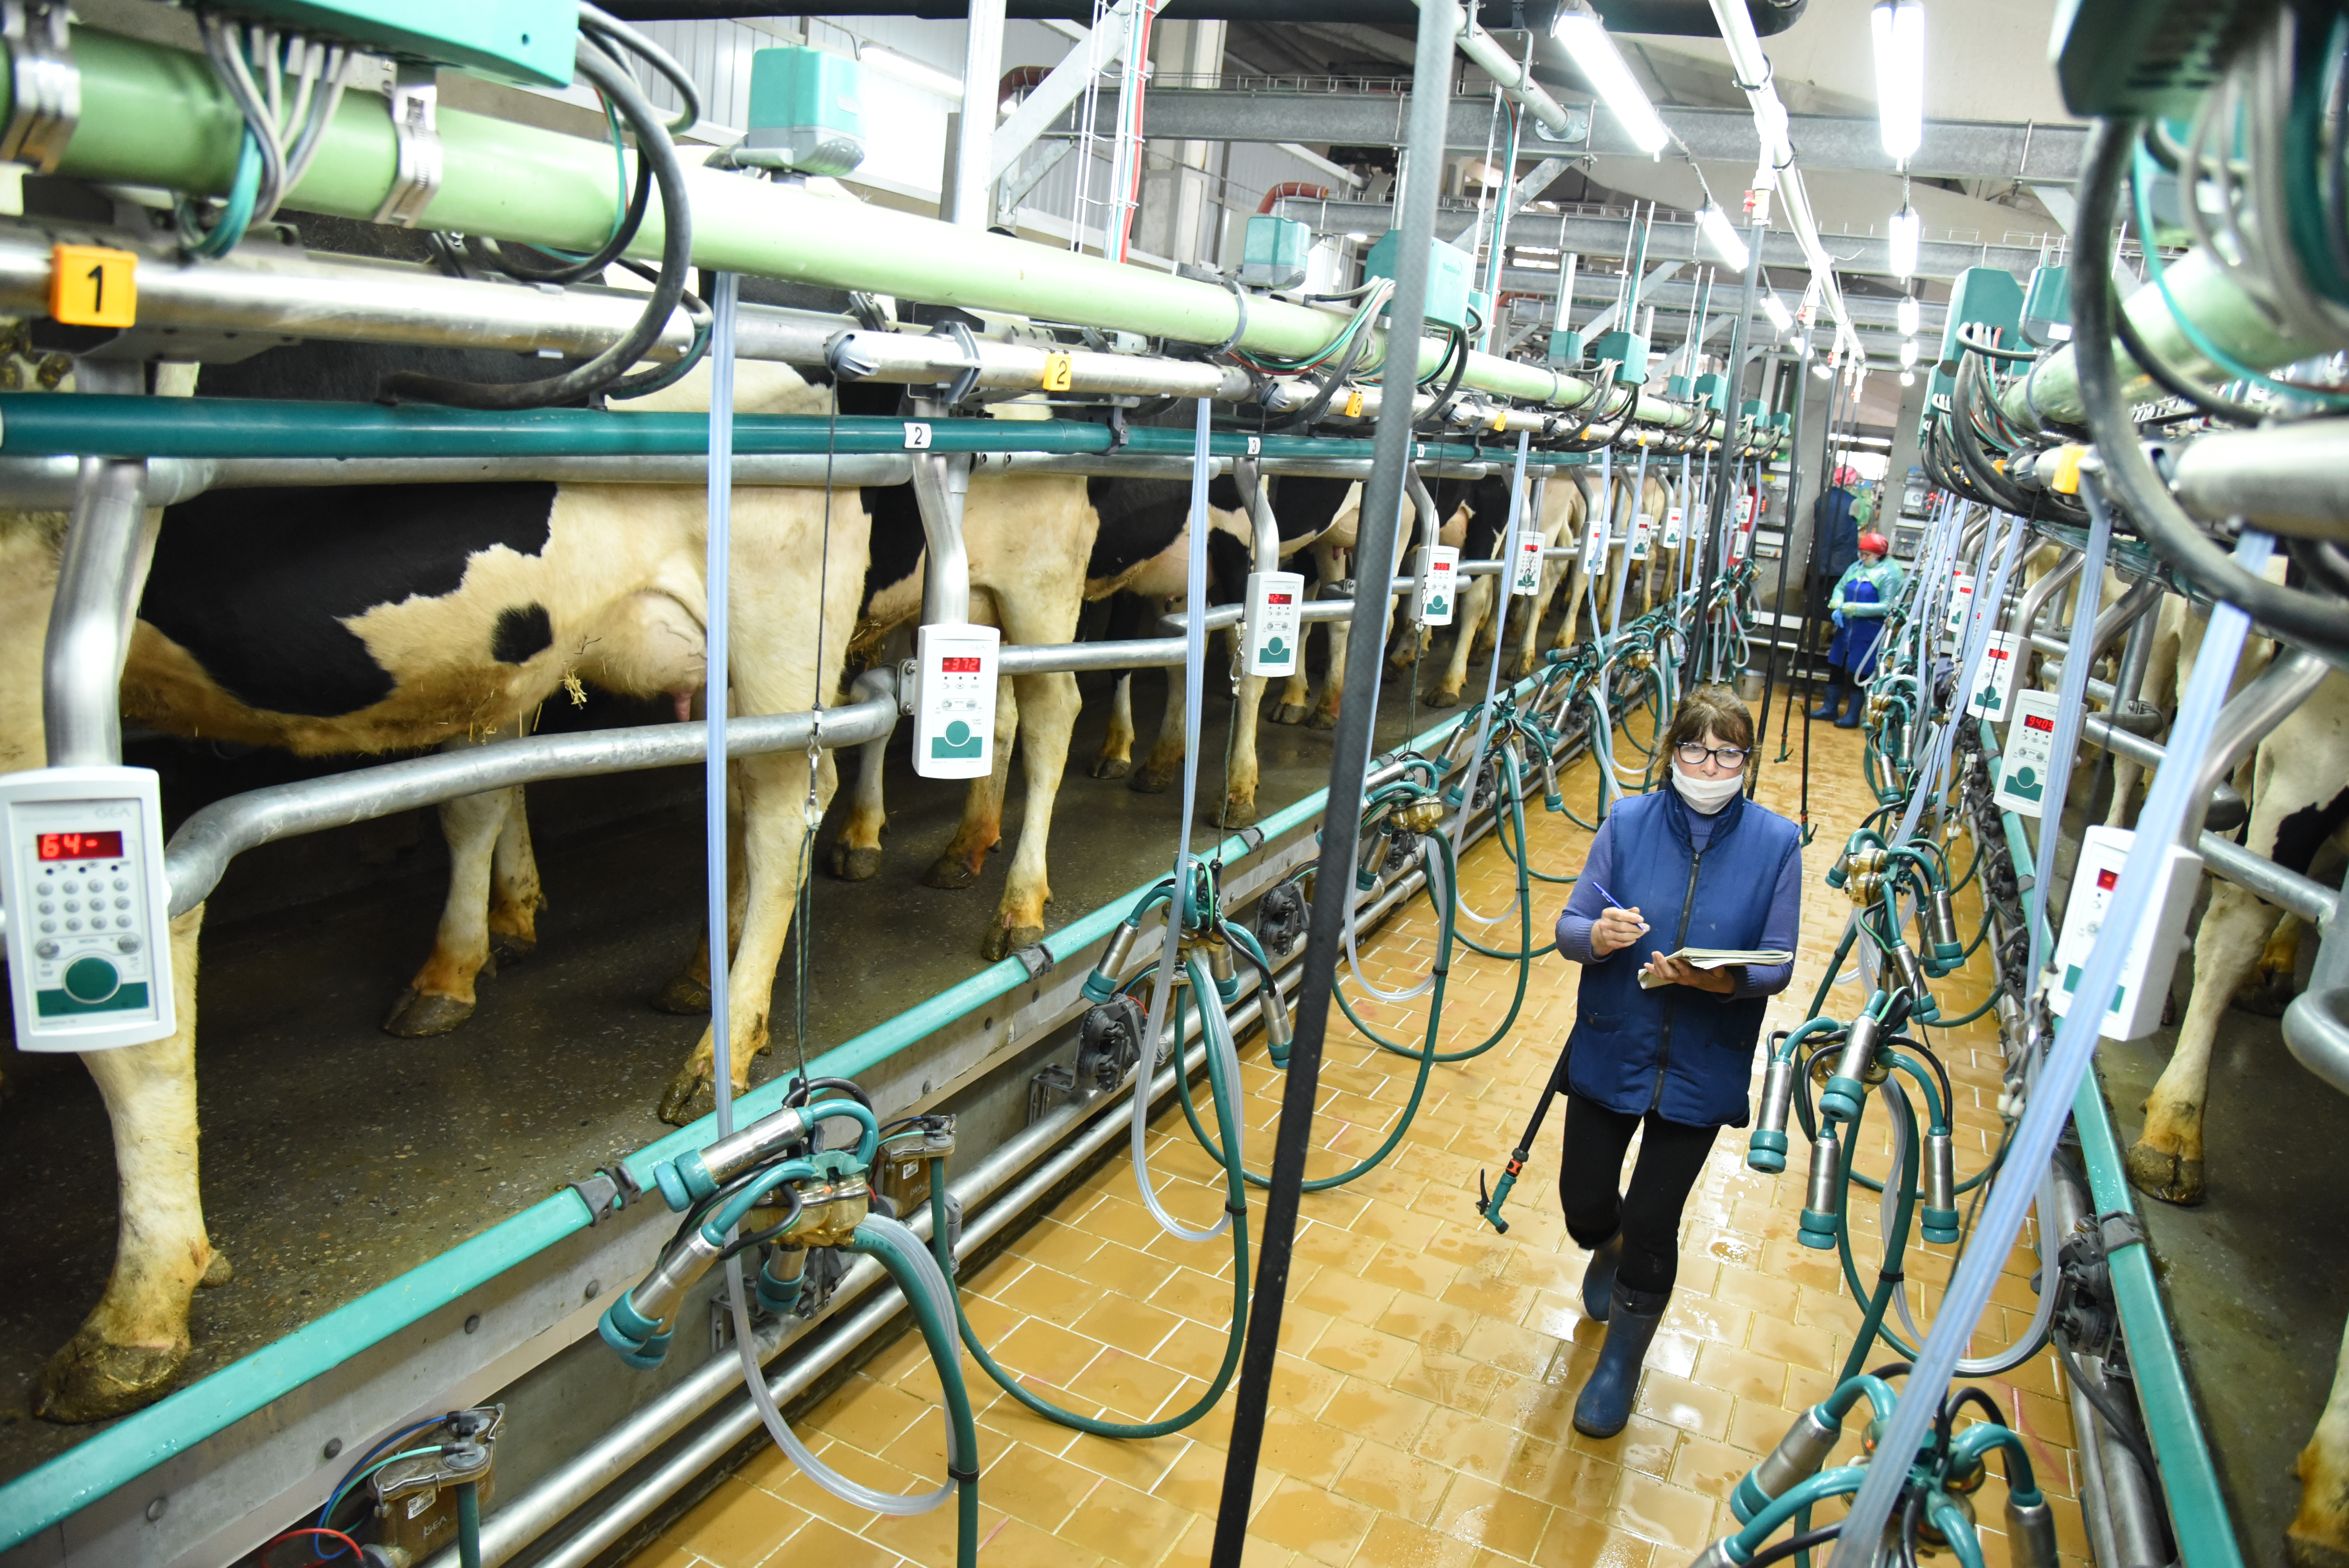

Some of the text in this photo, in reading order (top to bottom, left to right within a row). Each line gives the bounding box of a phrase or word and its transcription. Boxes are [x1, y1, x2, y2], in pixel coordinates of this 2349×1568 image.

[87, 265, 103, 313] 1
[1057, 360, 1067, 385] 2
[1353, 397, 1362, 414] 3
[914, 426, 922, 445] 2
[1252, 440, 1257, 453] 3
[425, 1515, 447, 1536] GEA
